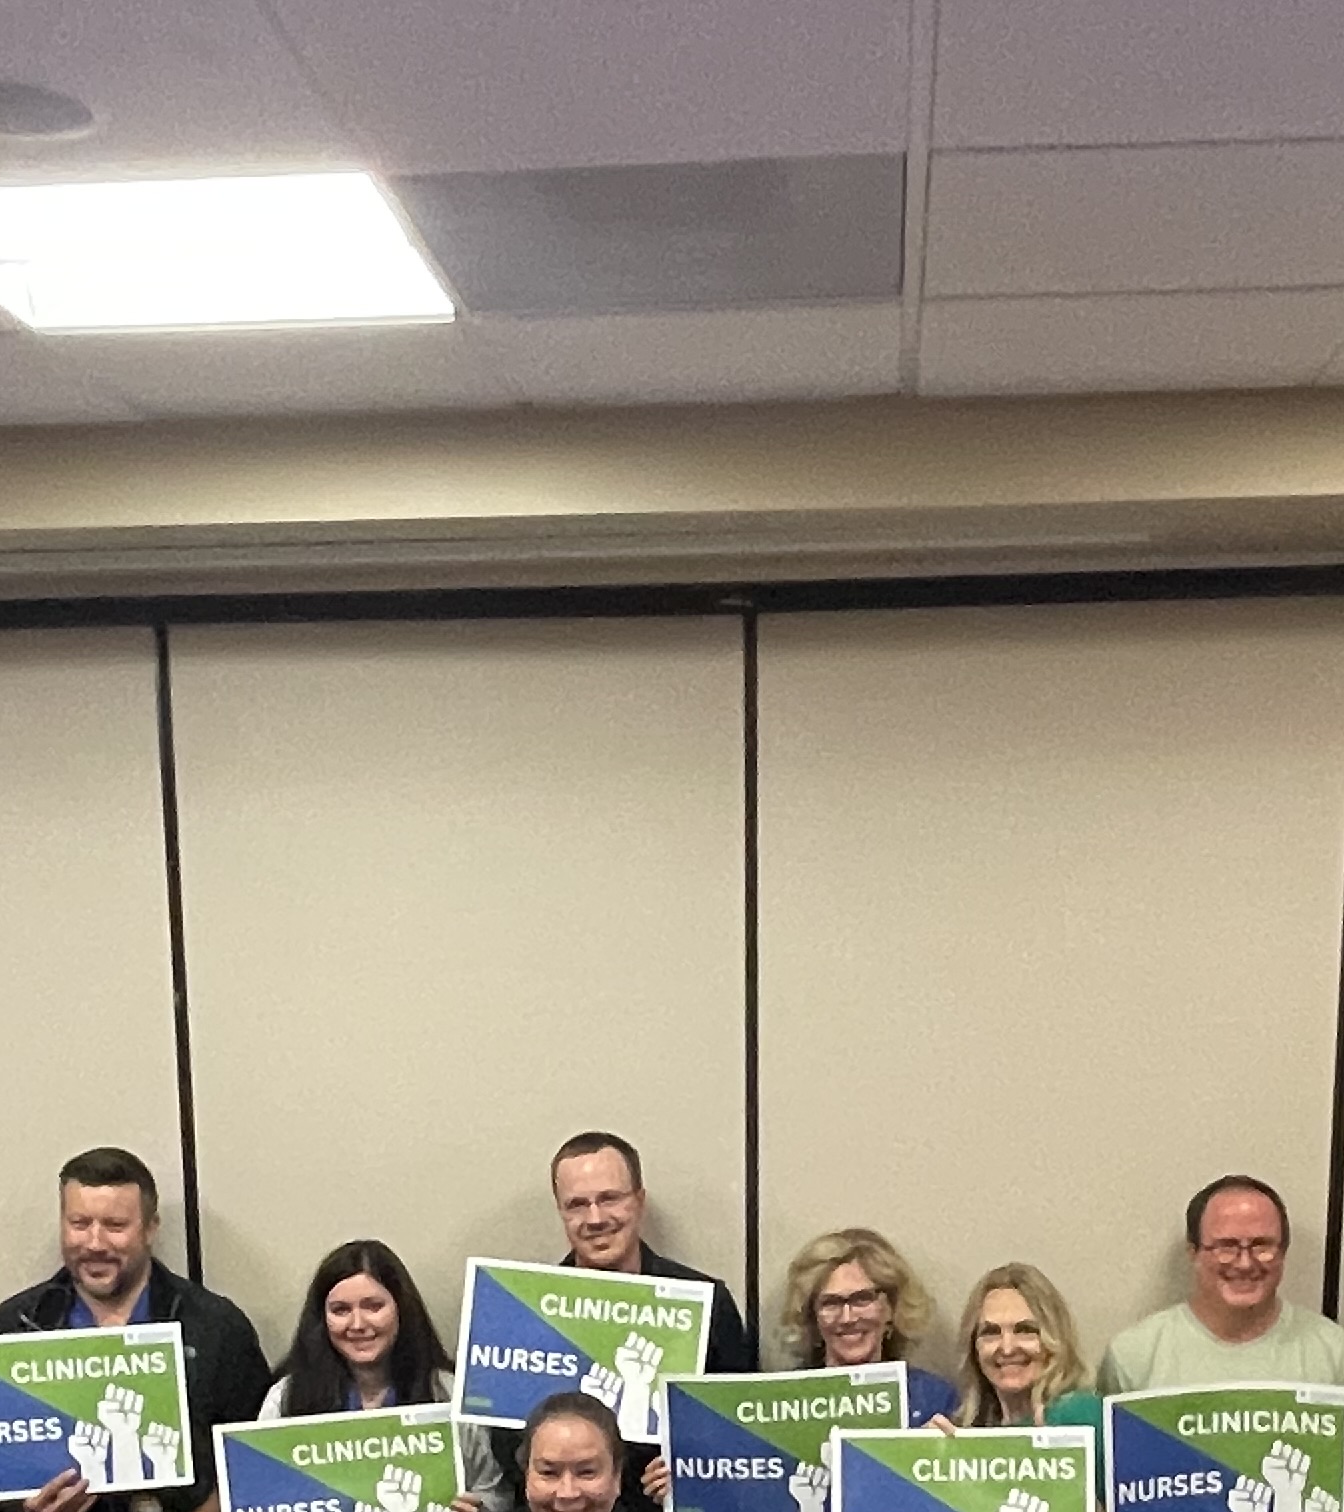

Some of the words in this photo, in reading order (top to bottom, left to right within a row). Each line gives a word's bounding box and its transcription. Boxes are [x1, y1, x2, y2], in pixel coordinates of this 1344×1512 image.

[541, 1294, 692, 1331] CLINICIANS
[11, 1352, 166, 1383] CLINICIANS
[471, 1345, 577, 1376] NURSES
[737, 1392, 891, 1423] CLINICIANS
[1178, 1411, 1336, 1436] CLINICIANS
[293, 1432, 444, 1465] CLINICIANS
[677, 1458, 783, 1479] NURSES
[913, 1457, 1075, 1481] CLINICIANS
[1119, 1471, 1223, 1504] NURSES
